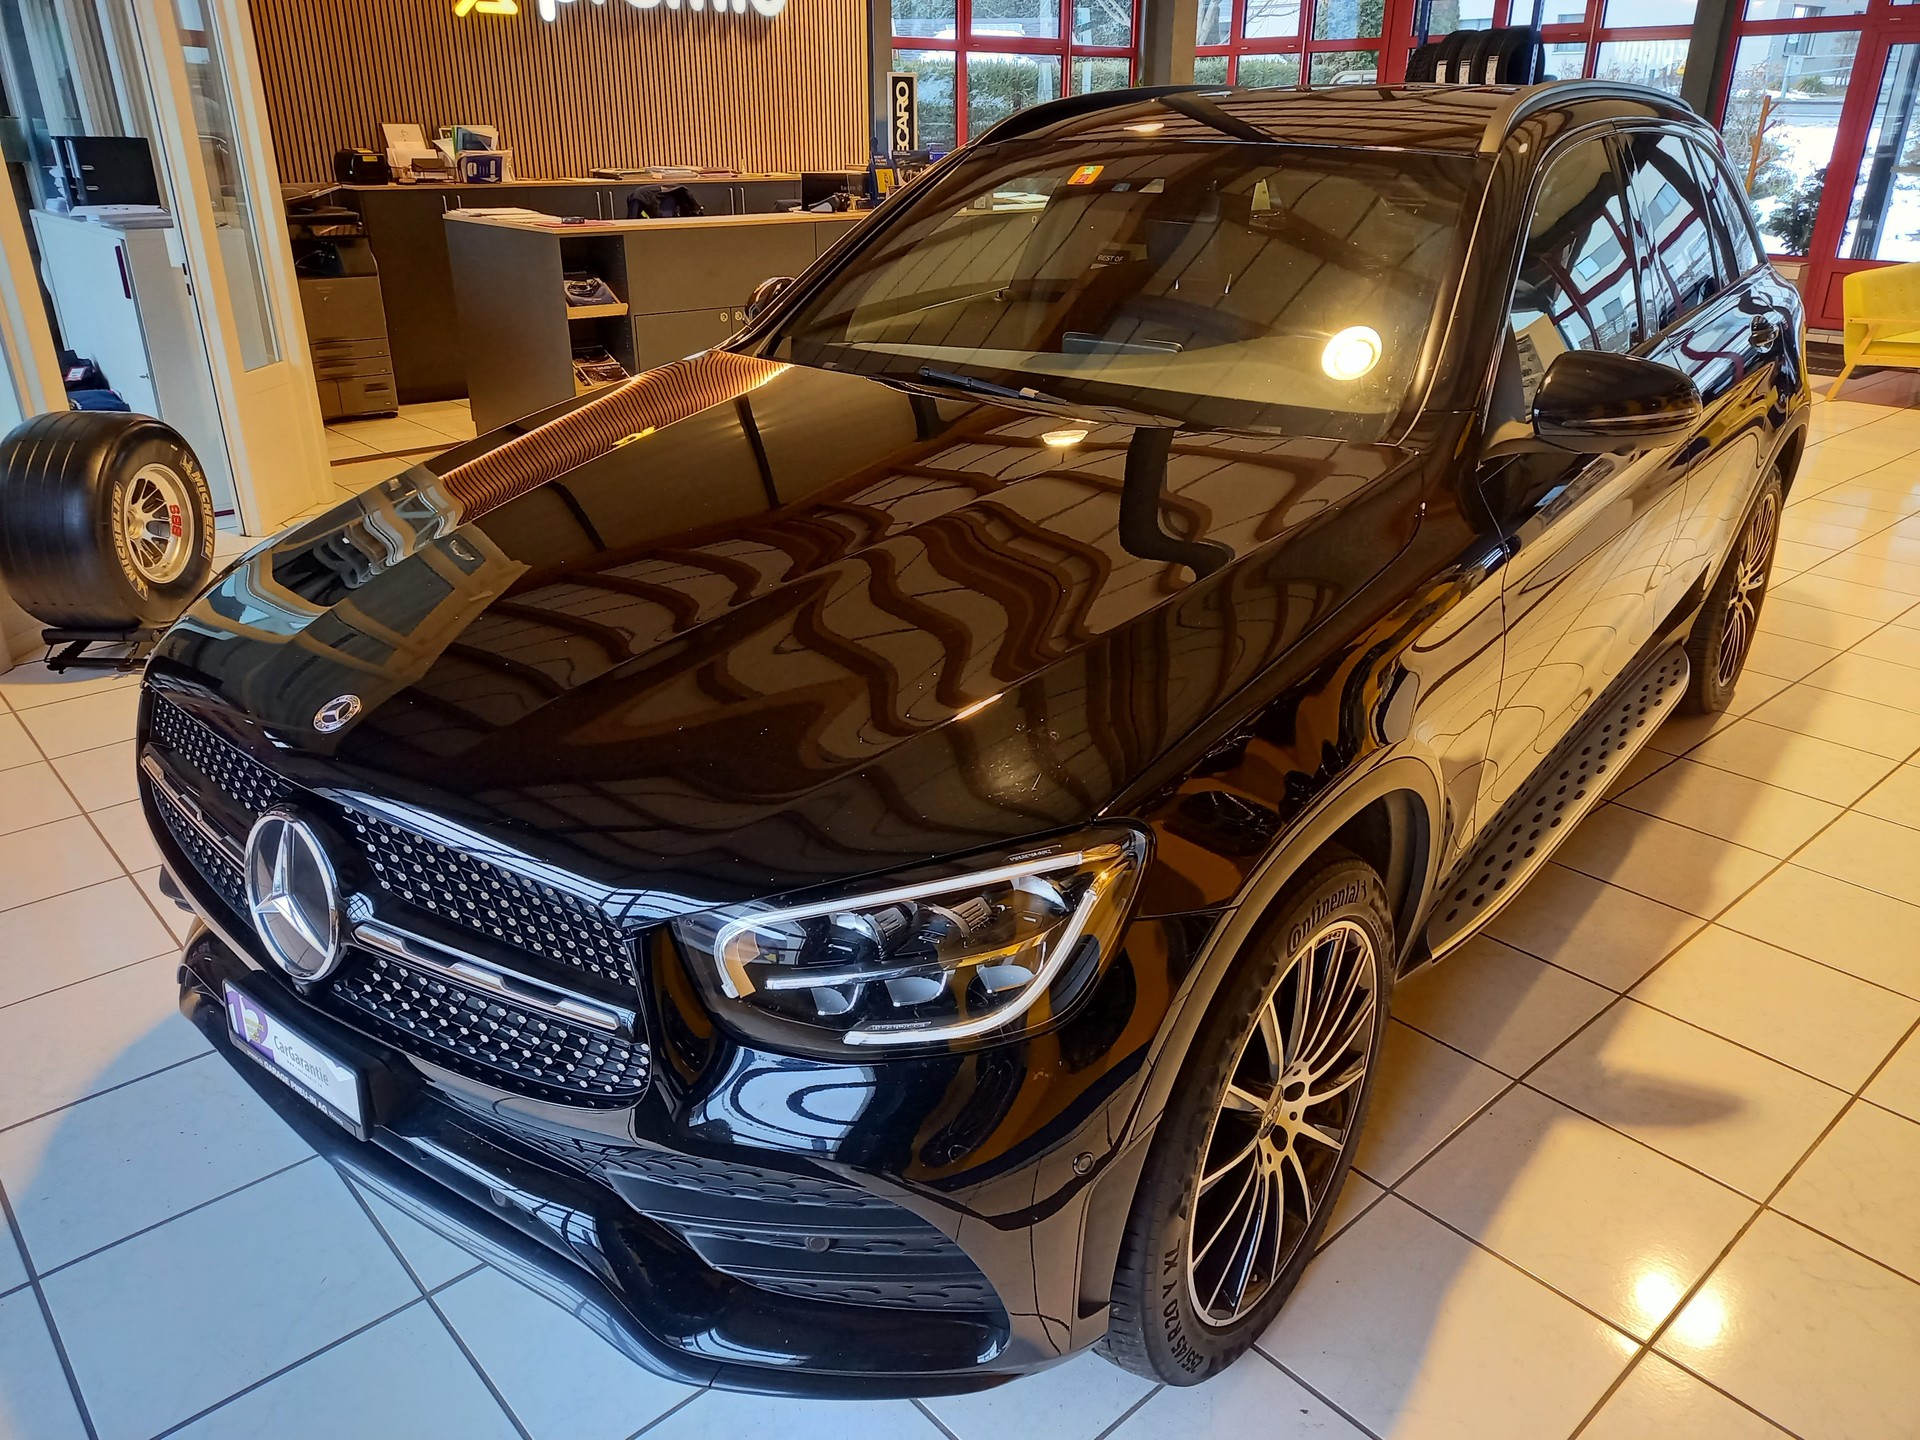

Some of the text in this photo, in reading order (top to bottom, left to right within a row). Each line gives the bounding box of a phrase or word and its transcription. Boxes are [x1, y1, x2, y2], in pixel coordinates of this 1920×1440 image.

[113, 485, 136, 582] MICHELIN
[169, 504, 182, 537] BBS
[191, 471, 213, 559] MICHELIN
[1287, 879, 1361, 958] Continental
[273, 1035, 329, 1086] CarGarantie
[1163, 1238, 1180, 1275] XL
